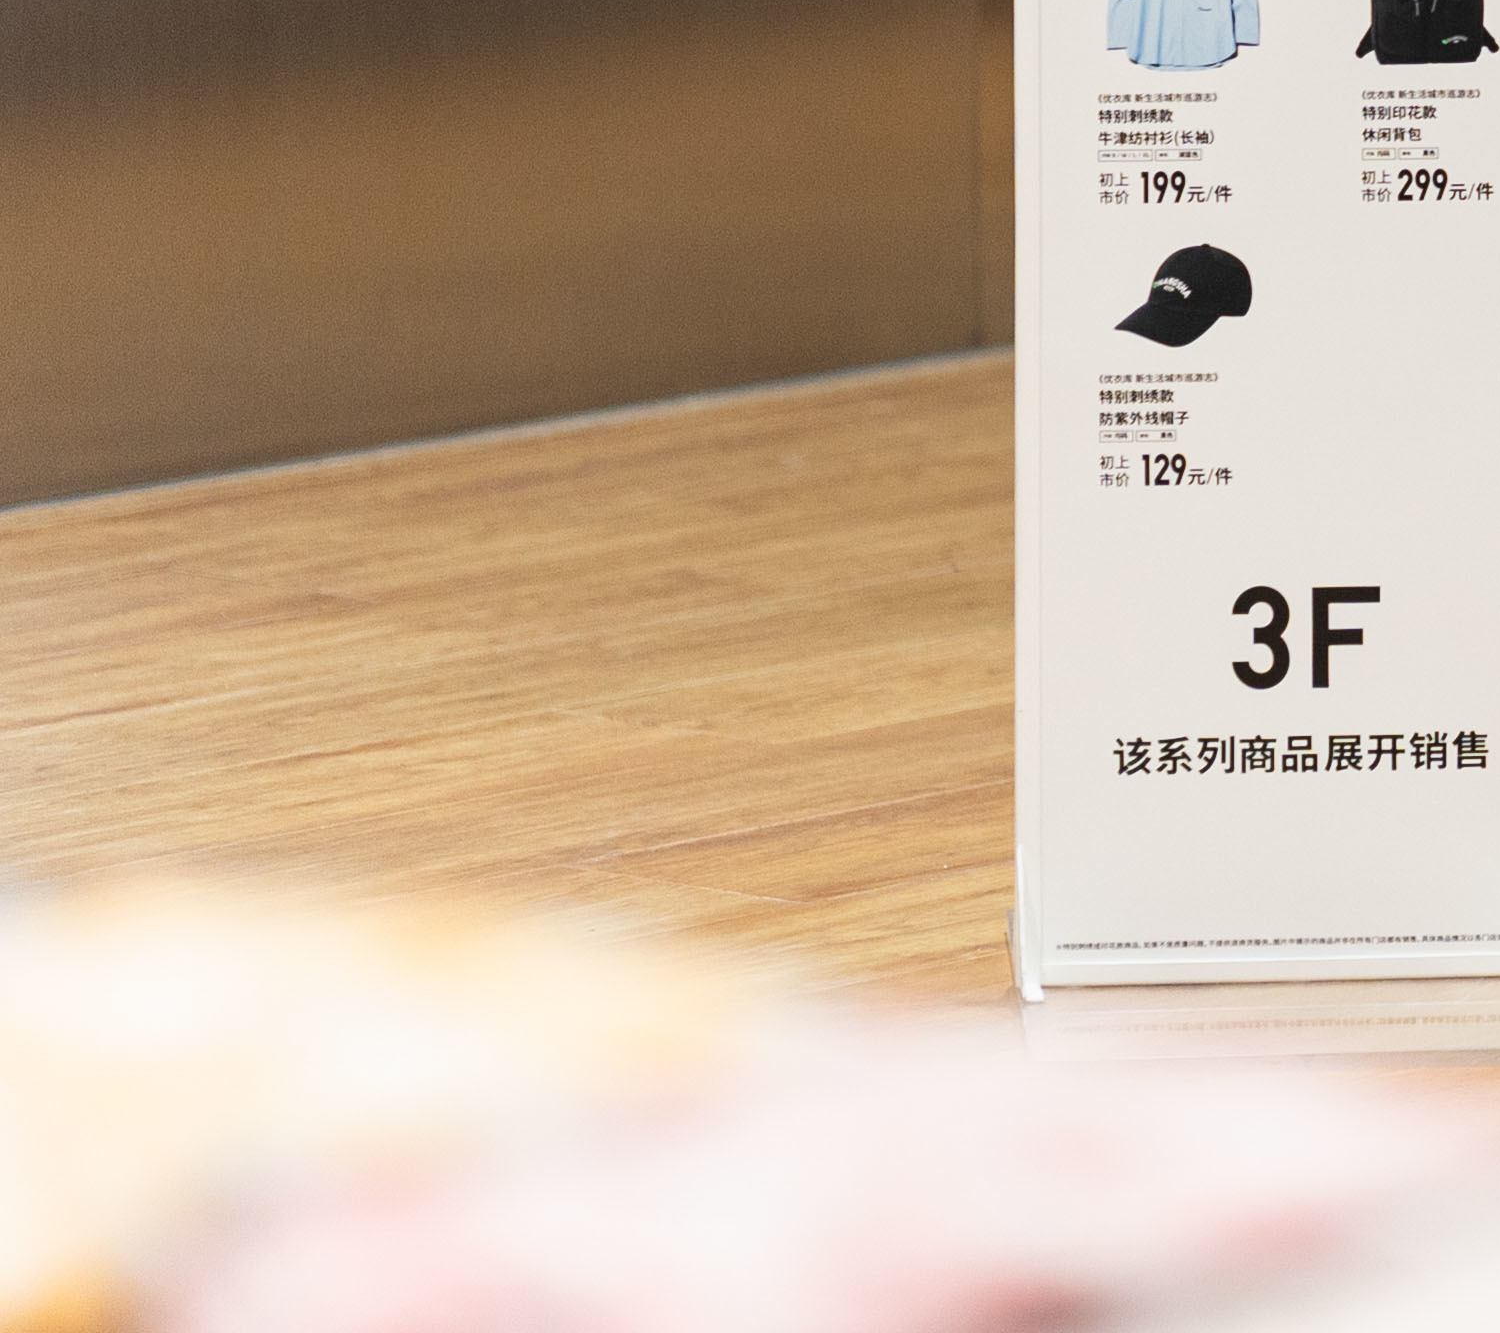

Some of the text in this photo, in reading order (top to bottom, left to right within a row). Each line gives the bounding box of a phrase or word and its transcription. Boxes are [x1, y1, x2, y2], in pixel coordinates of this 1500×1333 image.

[1098, 109, 1173, 124] 特别刺绣款
[1362, 105, 1437, 120] 特别印花款
[1099, 389, 1174, 404] 特别刺绣款
[1232, 586, 1380, 690] 3F
[1113, 731, 1488, 775] 该系列商品展开销售
